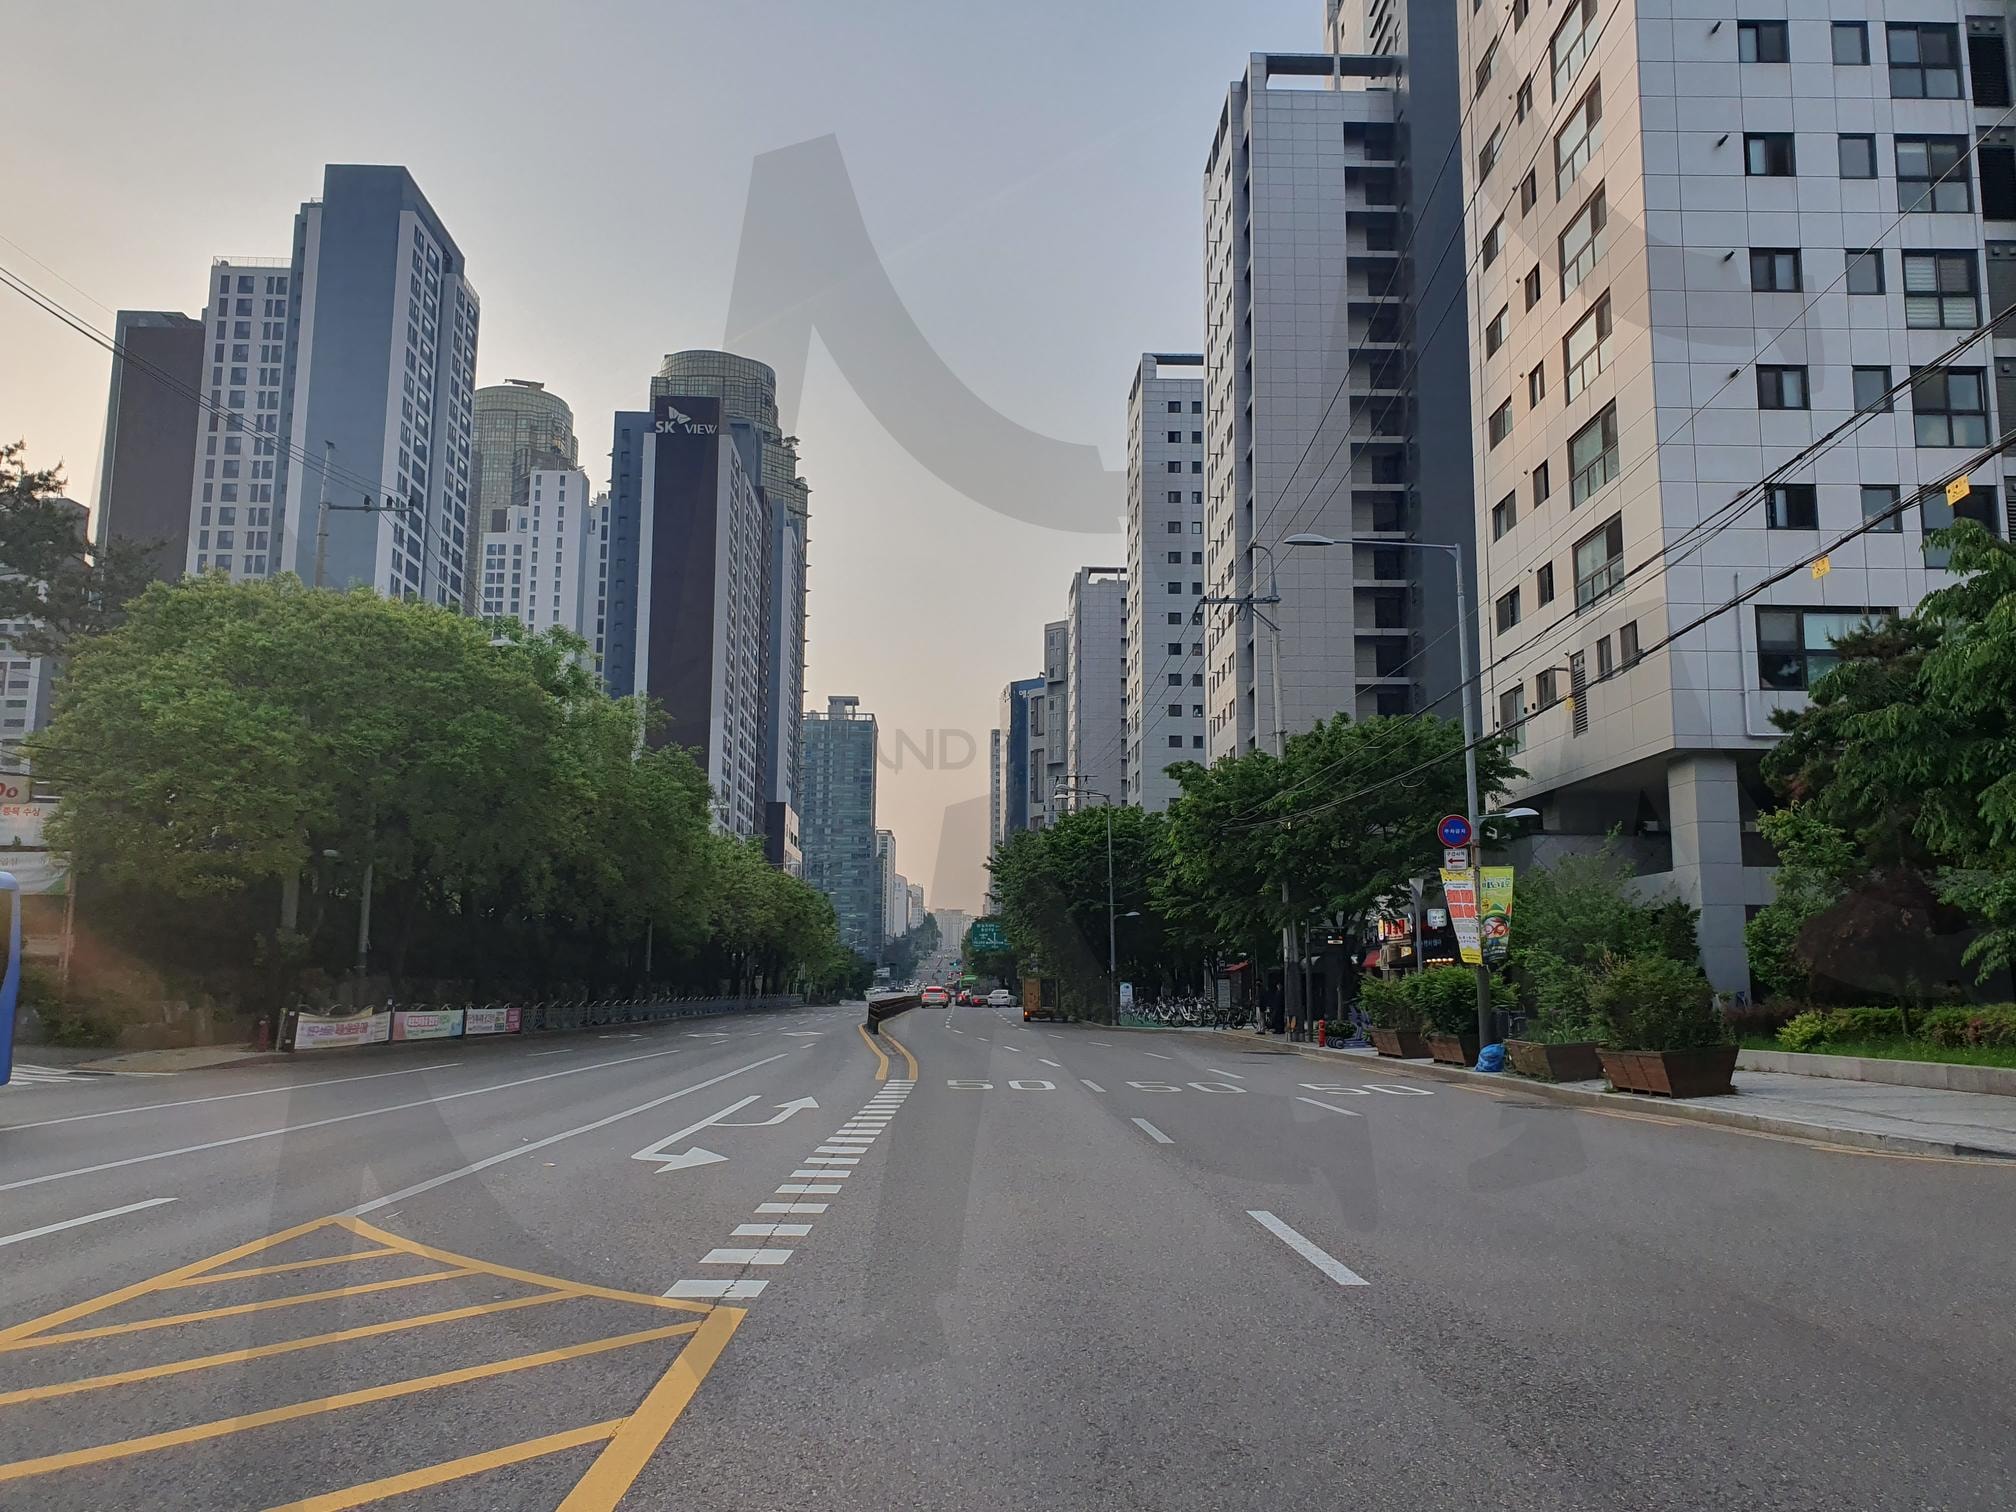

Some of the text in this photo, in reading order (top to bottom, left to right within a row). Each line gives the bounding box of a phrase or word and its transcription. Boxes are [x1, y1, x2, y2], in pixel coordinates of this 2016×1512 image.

[655, 421, 717, 434] SK VIEW
[947, 1079, 1057, 1091] 50
[1126, 1081, 1248, 1093] 50
[1298, 1083, 1435, 1095] 50
